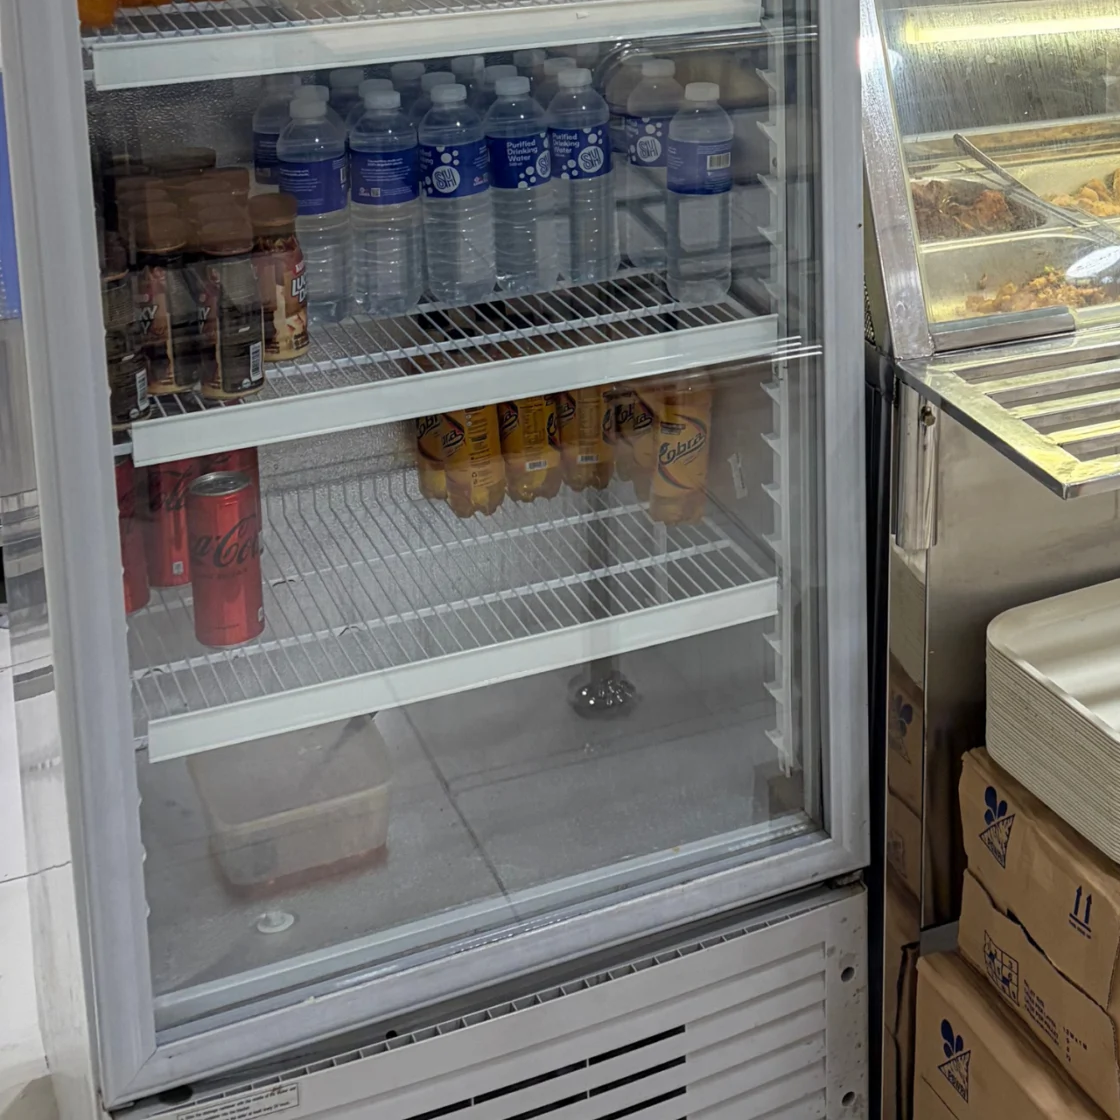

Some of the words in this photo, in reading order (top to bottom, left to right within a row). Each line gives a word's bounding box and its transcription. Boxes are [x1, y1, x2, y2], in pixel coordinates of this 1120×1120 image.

[552, 132, 578, 141] Purified
[506, 139, 536, 149] Purified
[552, 139, 580, 148] Drinking
[507, 147, 538, 156] Drinking
[659, 431, 706, 467] Cobra
